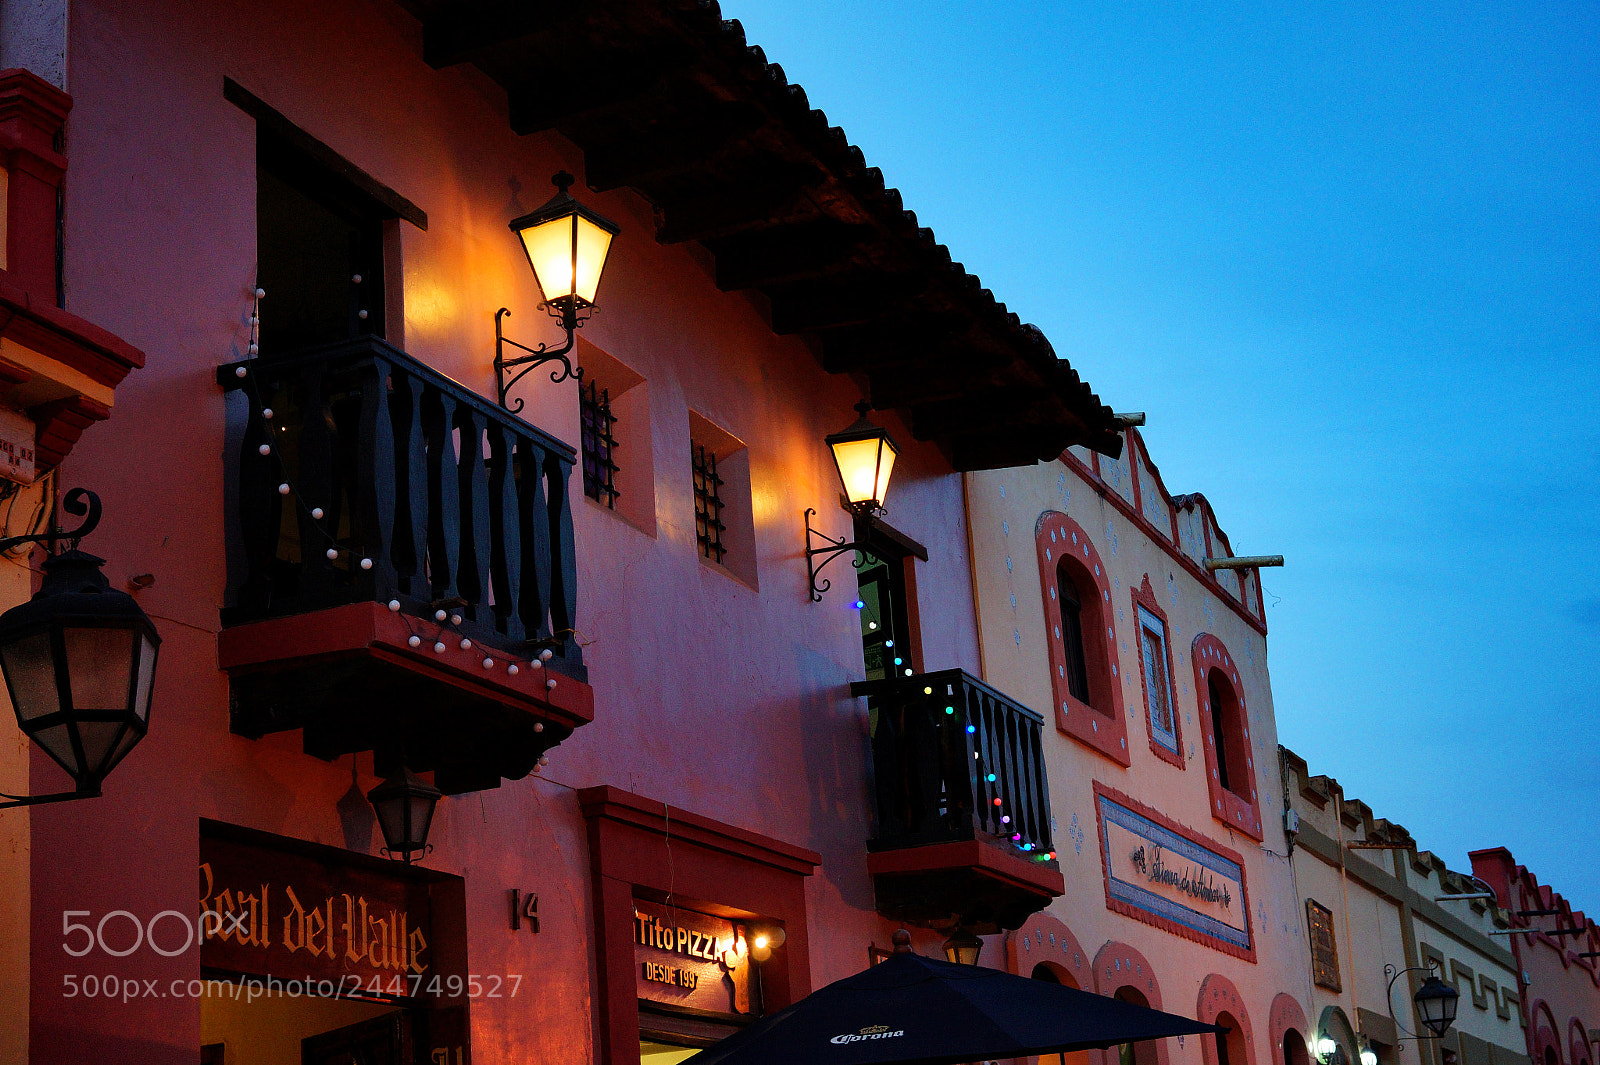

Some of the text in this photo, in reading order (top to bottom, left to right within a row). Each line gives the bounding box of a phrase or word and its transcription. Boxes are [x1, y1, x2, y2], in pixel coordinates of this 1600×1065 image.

[283, 885, 337, 960] del
[341, 893, 429, 975] Valle
[509, 889, 540, 933] 14
[636, 911, 724, 962] Tito PIZZA
[646, 957, 676, 985] DESDE
[830, 1030, 904, 1045] Corona
